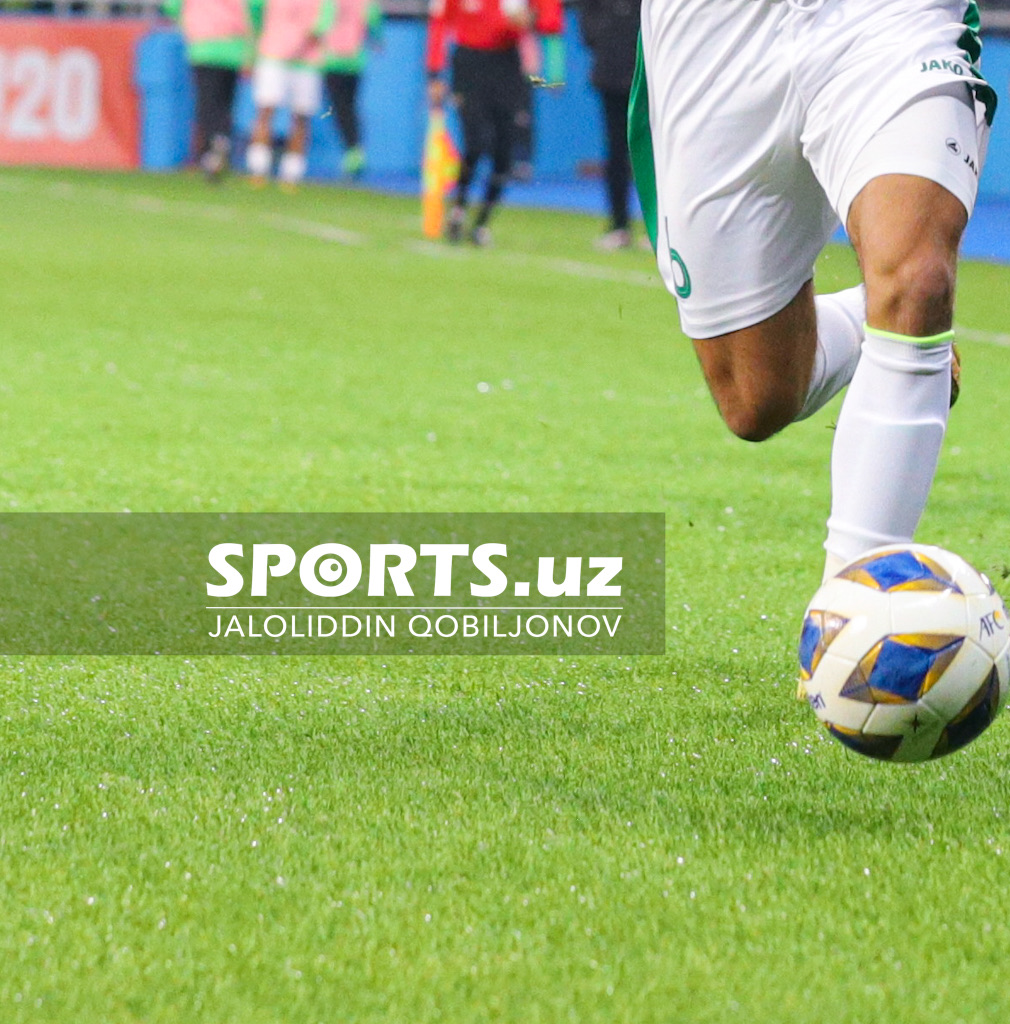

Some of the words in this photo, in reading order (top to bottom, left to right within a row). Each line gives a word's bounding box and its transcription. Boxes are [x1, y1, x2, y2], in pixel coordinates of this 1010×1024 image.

[920, 59, 963, 76] JAKO
[0, 48, 101, 141] 20
[963, 154, 978, 177] JA
[979, 609, 1005, 641] AFC
